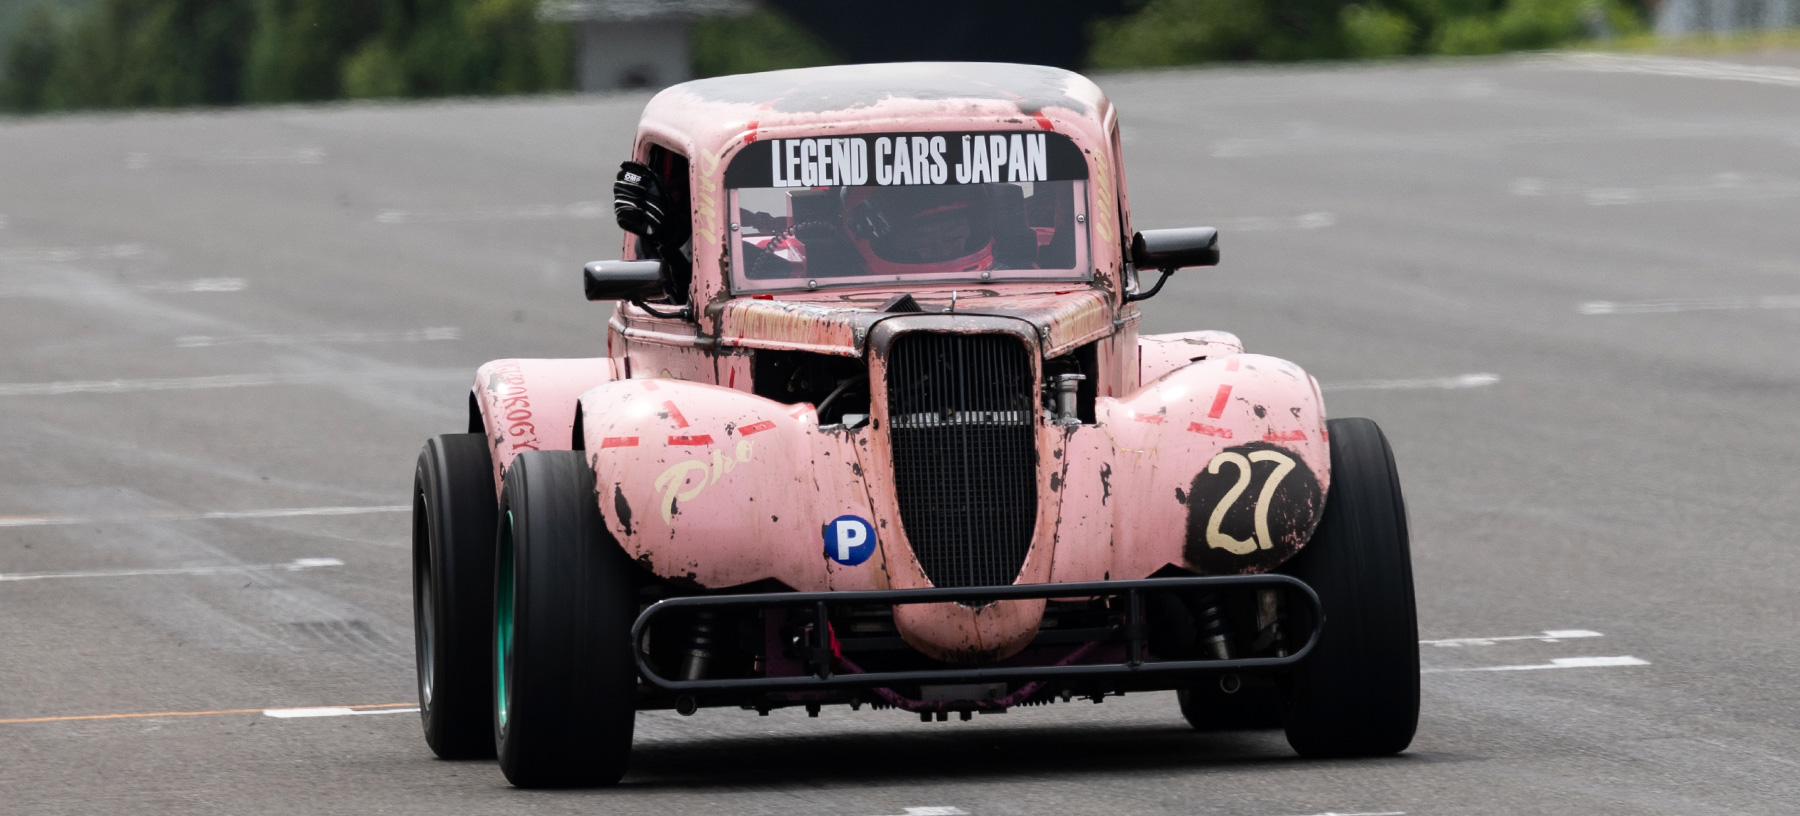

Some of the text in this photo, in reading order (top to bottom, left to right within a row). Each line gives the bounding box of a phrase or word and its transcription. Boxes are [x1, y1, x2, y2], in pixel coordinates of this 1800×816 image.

[772, 133, 1048, 187] LEGEND CARS JAPAN
[1206, 449, 1296, 555] 27
[836, 520, 867, 560] P
